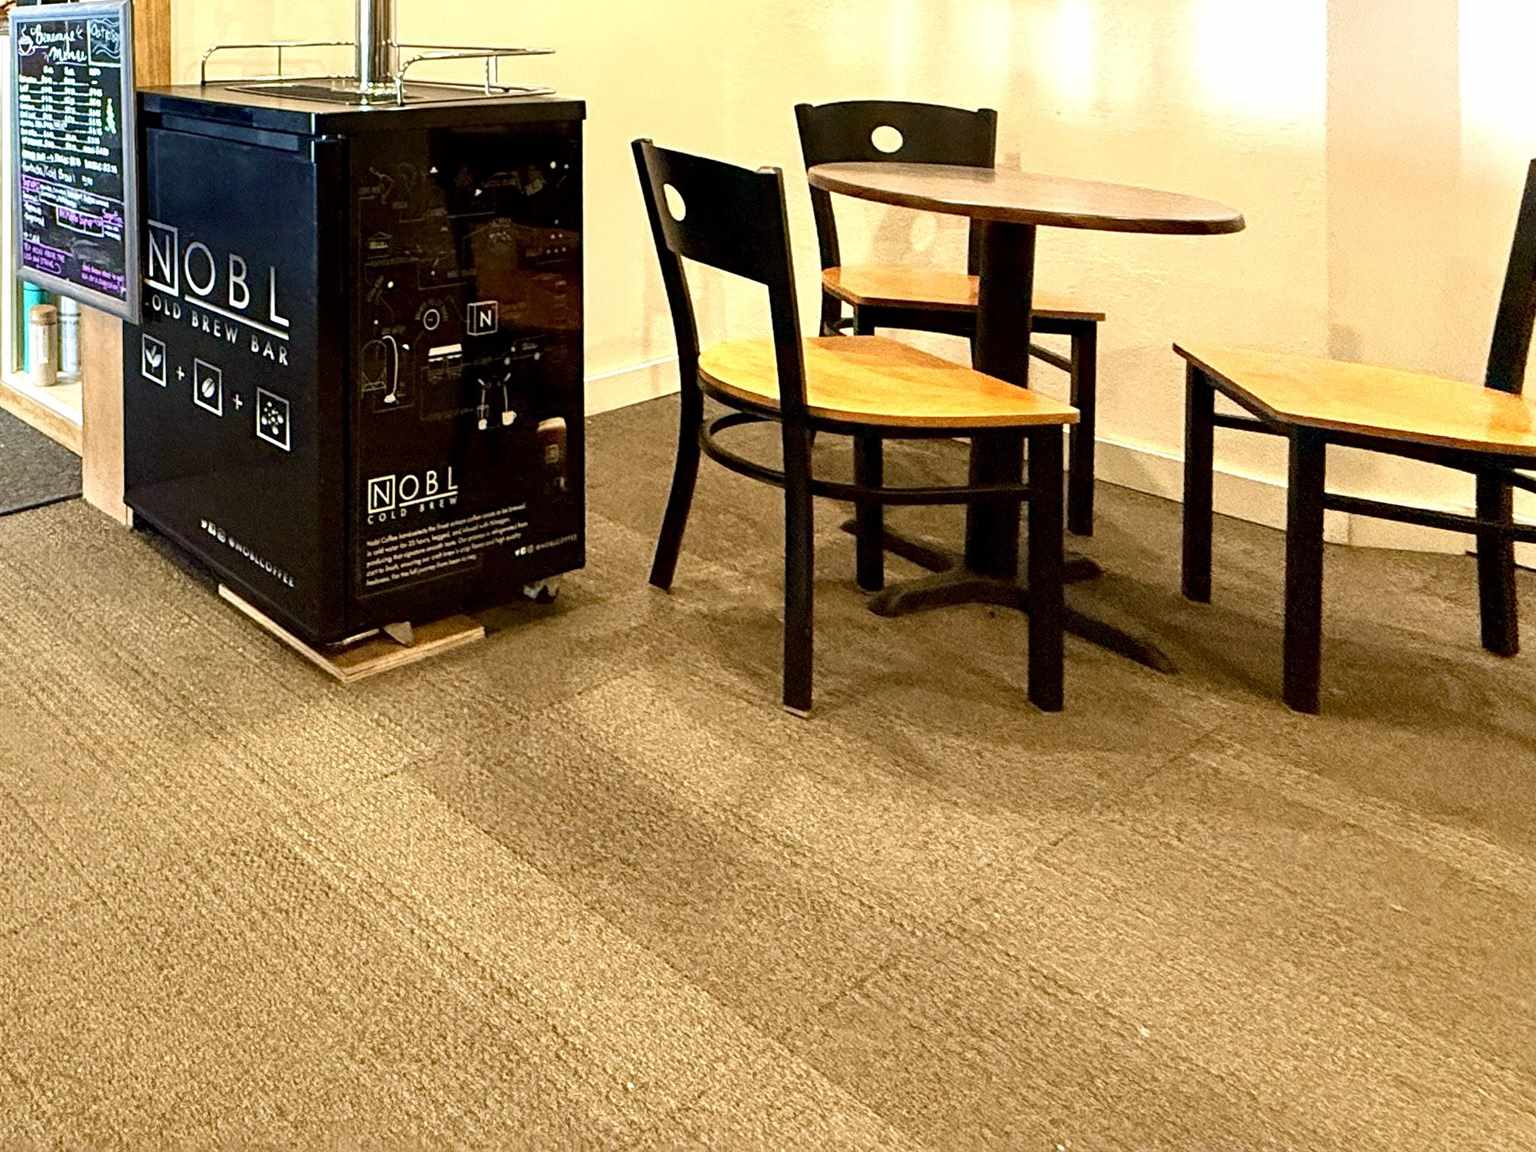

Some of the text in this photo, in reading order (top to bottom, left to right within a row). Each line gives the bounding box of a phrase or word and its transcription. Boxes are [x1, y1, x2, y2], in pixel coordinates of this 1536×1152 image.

[148, 228, 290, 327] NOBL
[144, 295, 289, 366] OLD BREW BAR
[367, 497, 458, 525] COLD BREW
[372, 465, 459, 508] NOBL
